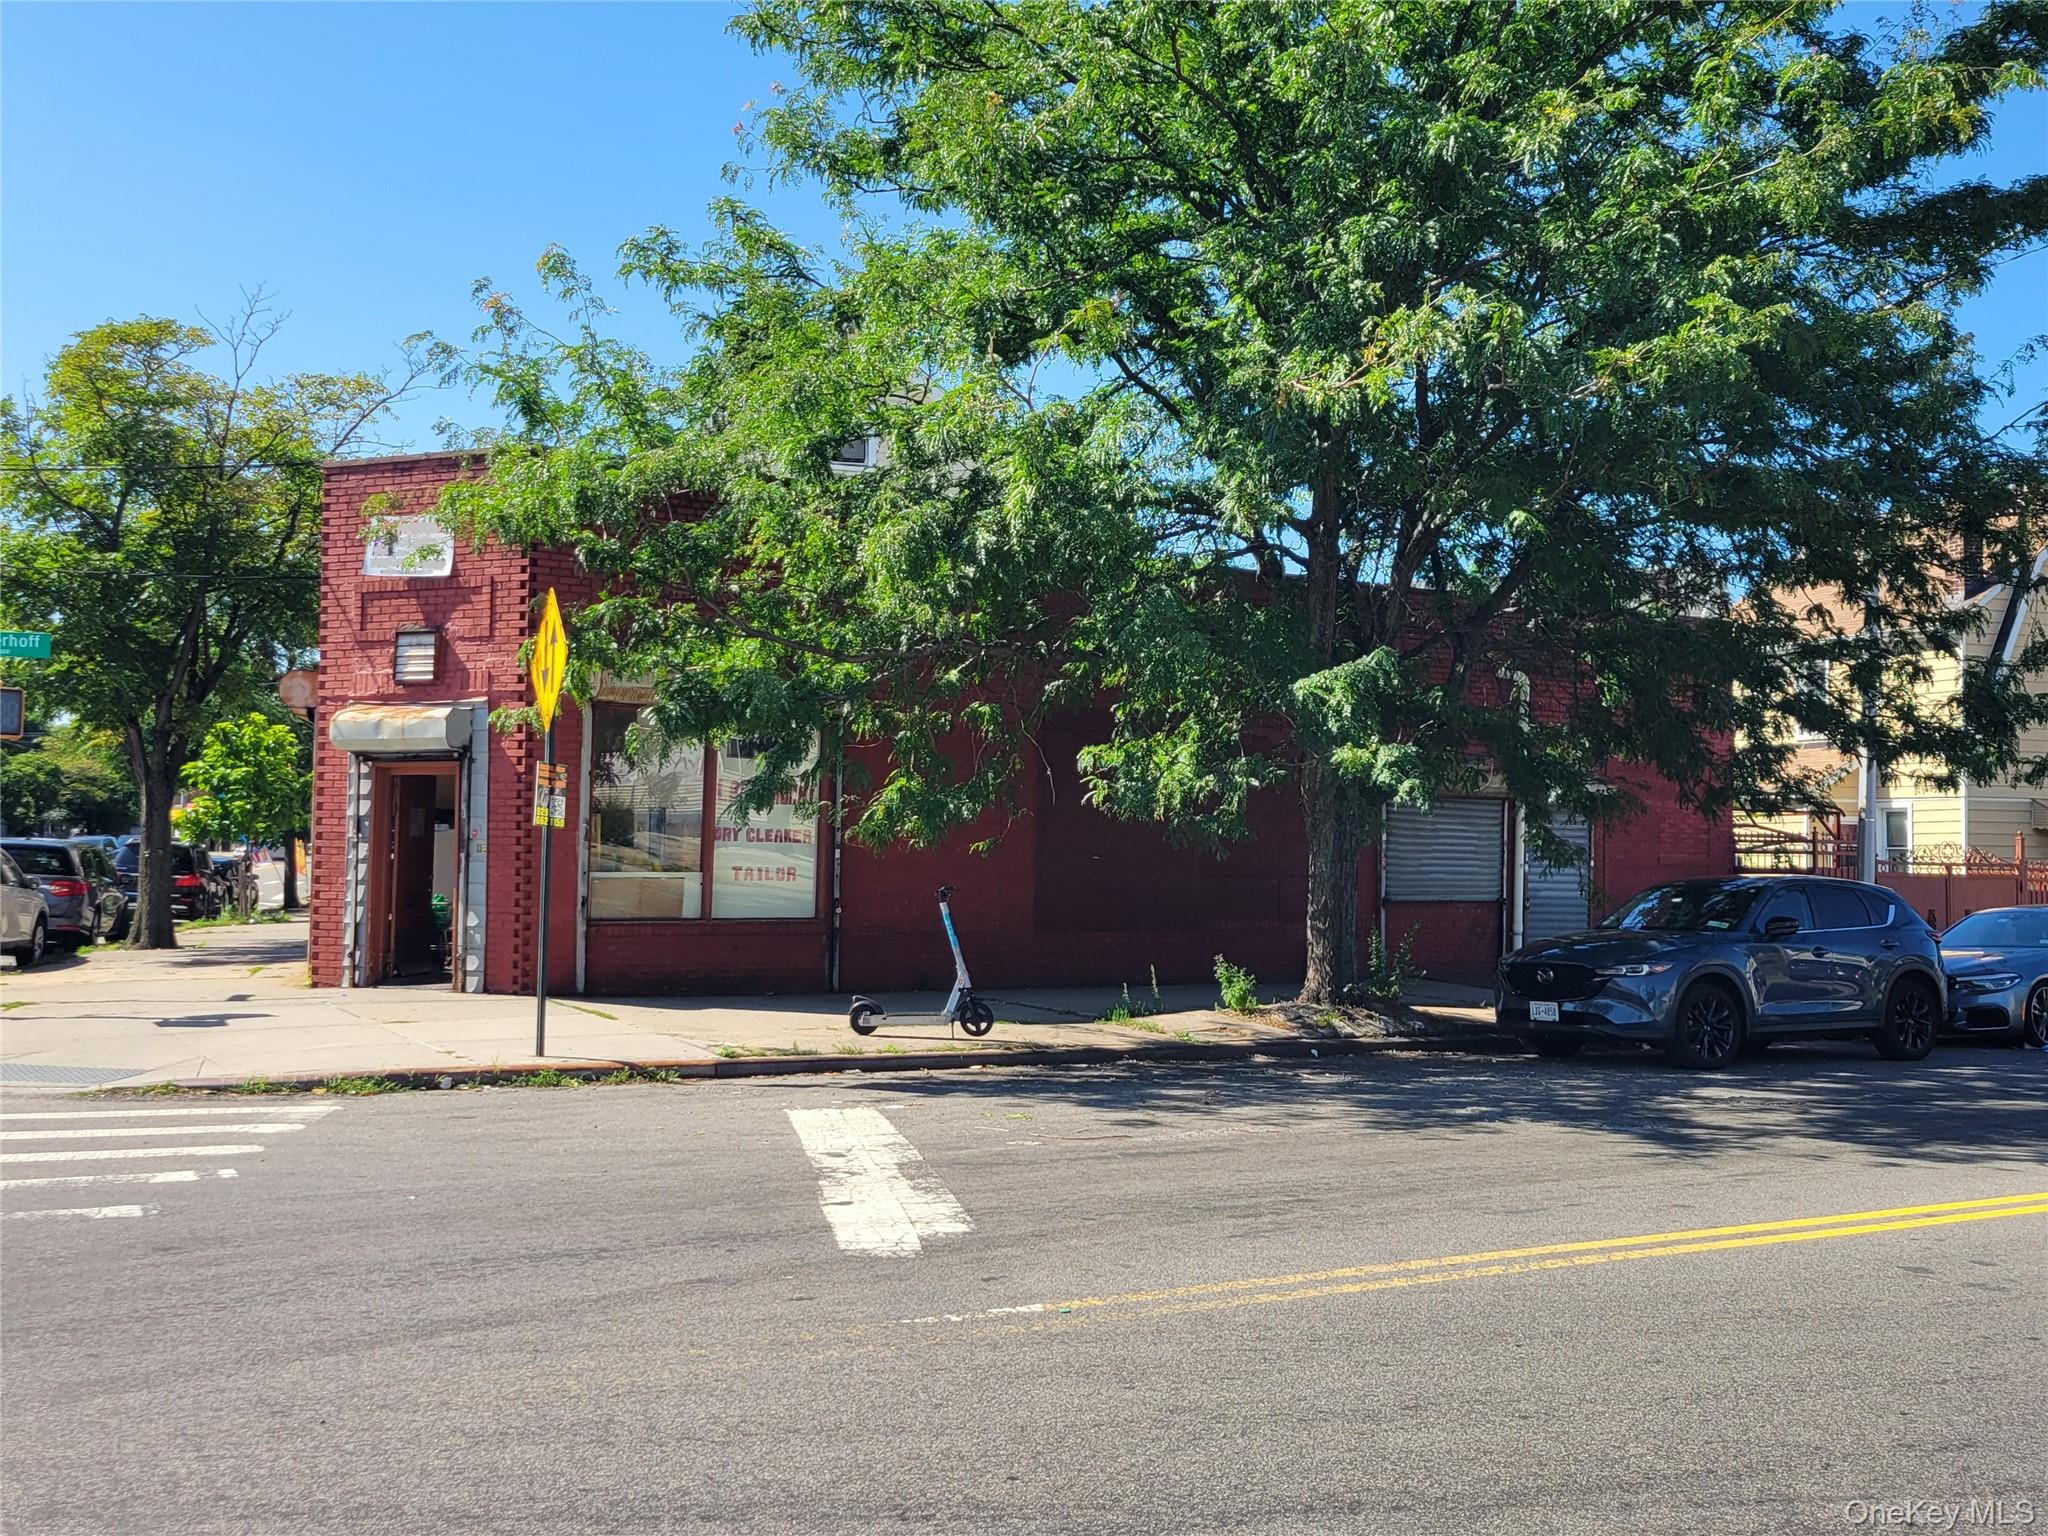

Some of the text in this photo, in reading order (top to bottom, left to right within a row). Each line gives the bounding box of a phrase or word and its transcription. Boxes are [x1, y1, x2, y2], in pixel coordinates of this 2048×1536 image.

[0, 634, 41, 648] rhoff
[714, 826, 742, 842] DRY
[731, 866, 797, 882] TAILOR
